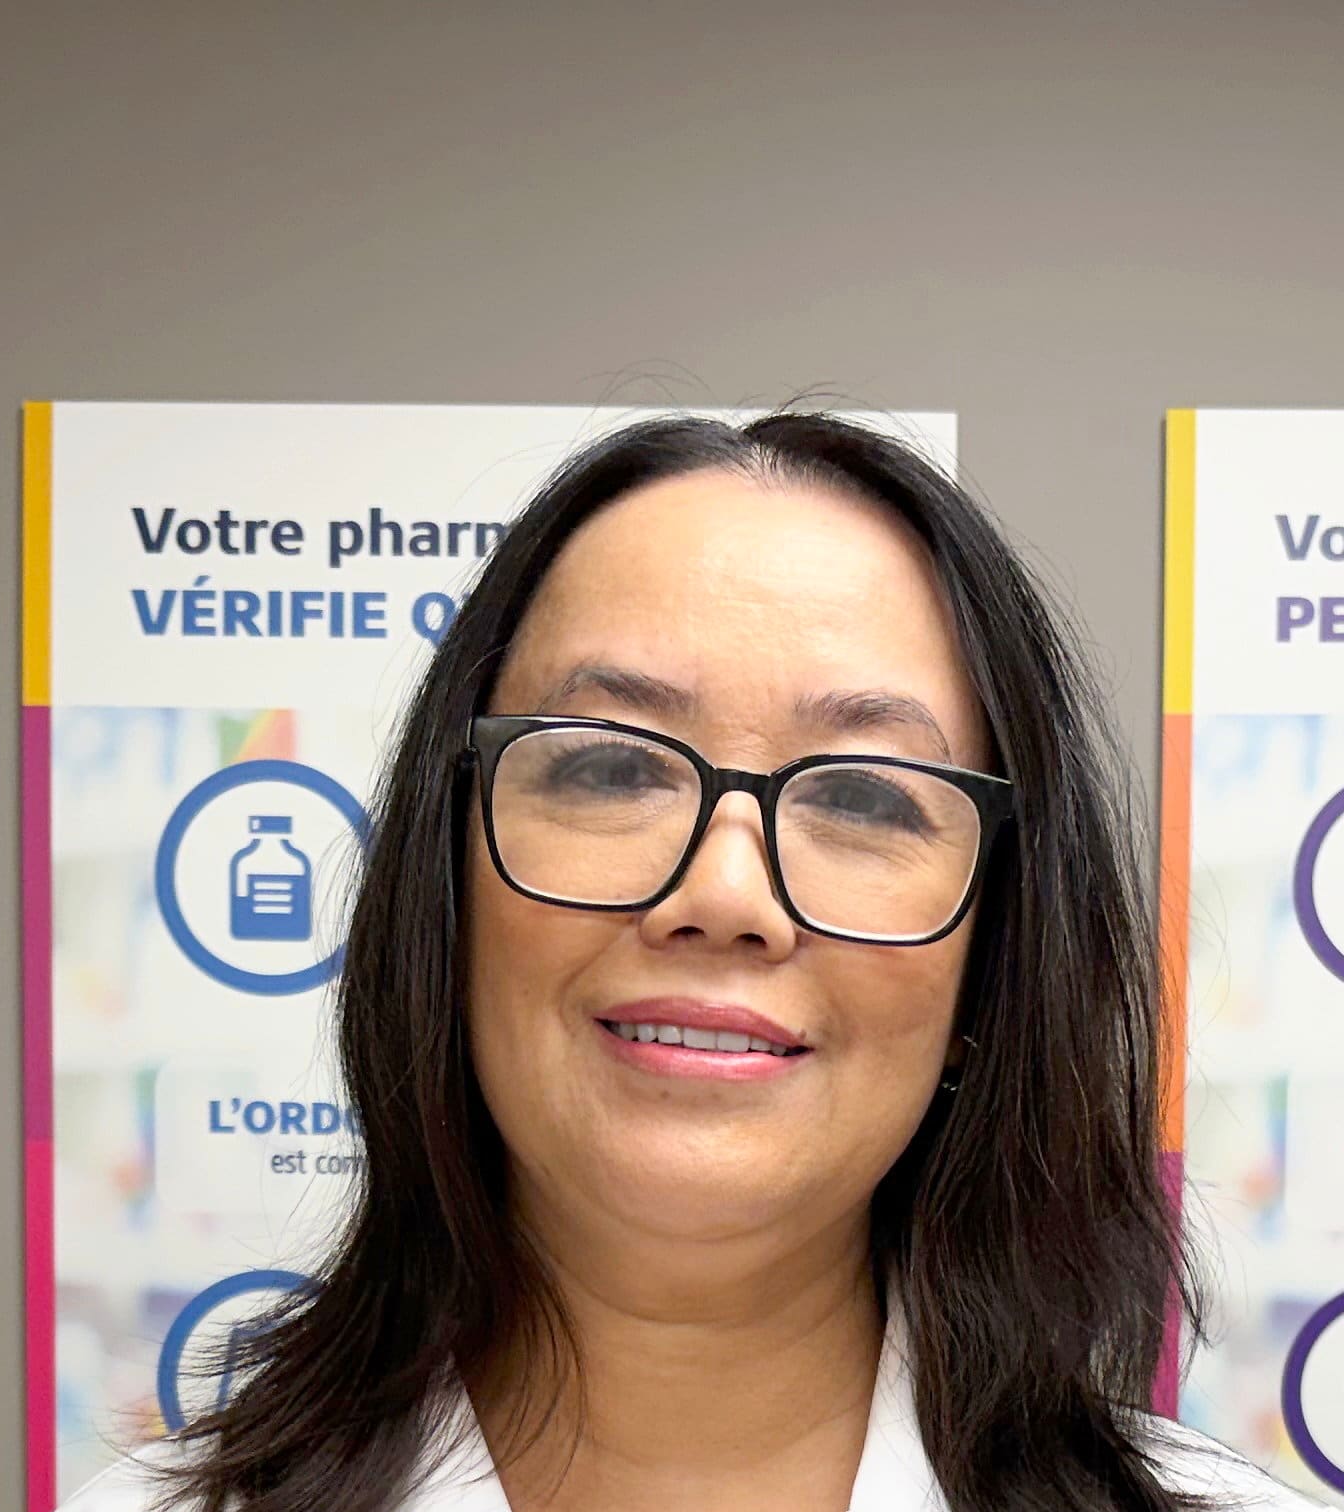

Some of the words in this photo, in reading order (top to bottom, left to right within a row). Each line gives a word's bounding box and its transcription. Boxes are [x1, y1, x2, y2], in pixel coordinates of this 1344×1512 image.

[130, 506, 305, 556] Votre
[130, 574, 388, 638] VÉRIFIE
[270, 1150, 307, 1174] est
